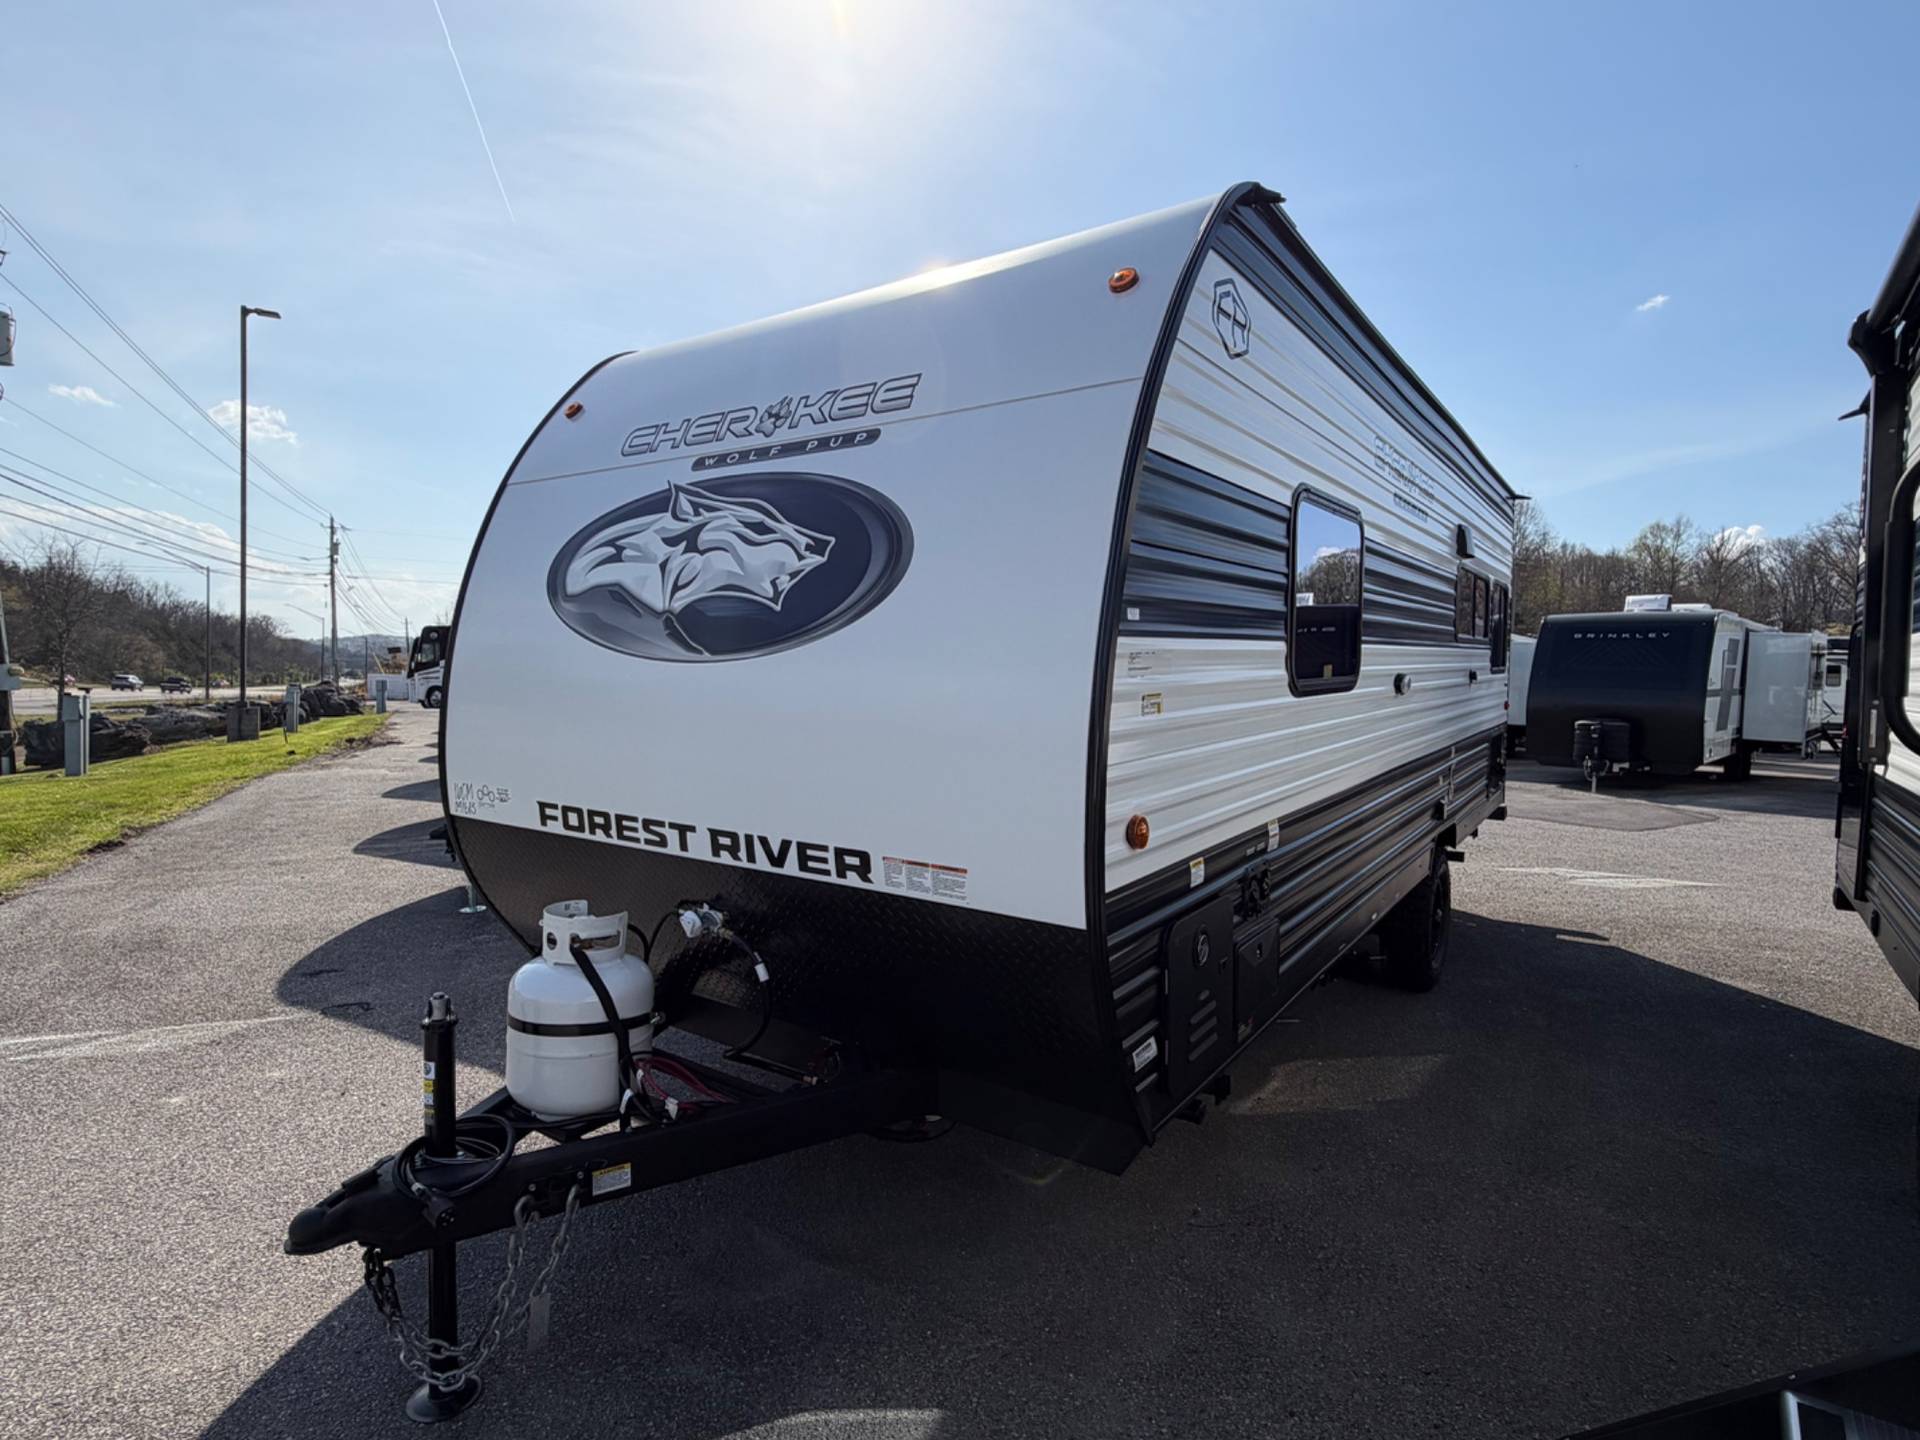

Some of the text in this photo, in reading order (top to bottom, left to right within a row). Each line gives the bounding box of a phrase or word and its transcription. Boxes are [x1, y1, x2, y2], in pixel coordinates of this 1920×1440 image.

[704, 432, 868, 467] WOLF PUP
[536, 801, 697, 852] FOREST
[706, 827, 874, 884] RIVER
